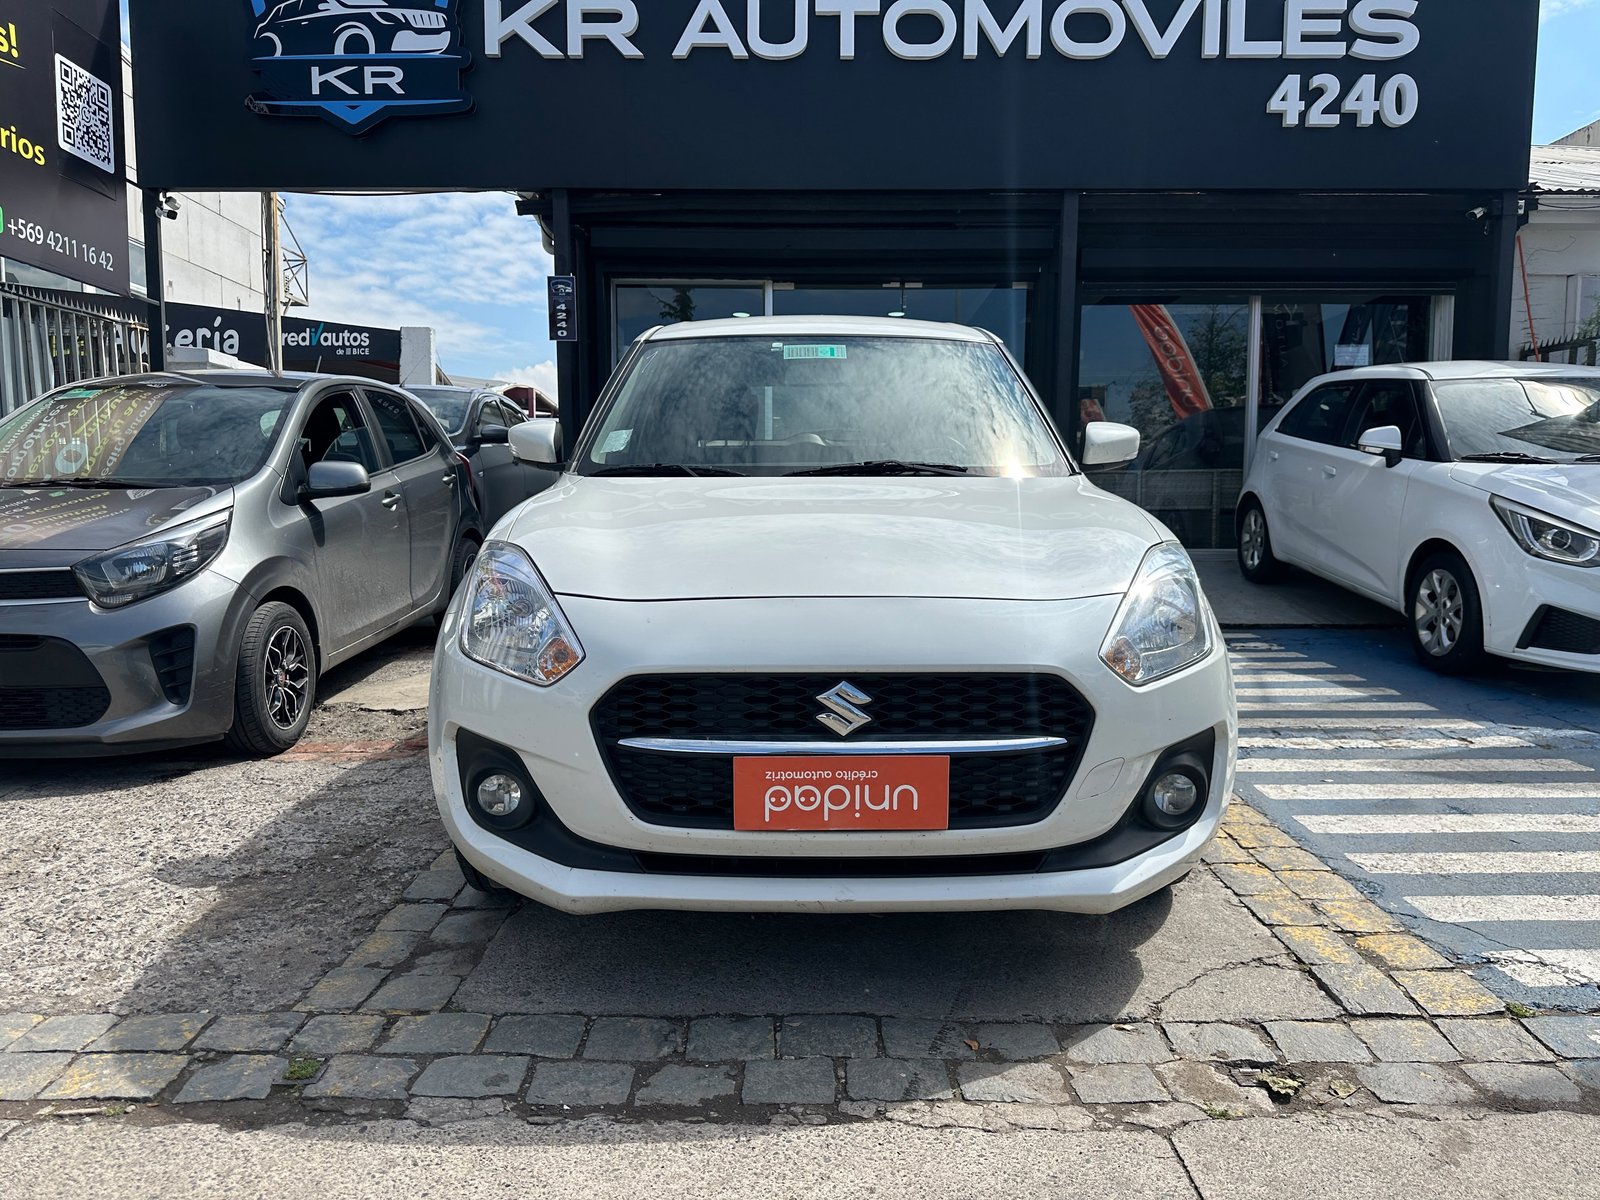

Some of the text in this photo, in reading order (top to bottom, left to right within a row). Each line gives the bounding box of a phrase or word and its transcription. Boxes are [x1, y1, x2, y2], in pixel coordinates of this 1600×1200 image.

[484, 0, 1420, 61] KR AUTOMOVILES
[310, 66, 406, 96] KR
[1266, 73, 1420, 129] 4240
[7, 217, 114, 272] +569 4211 16 42
[555, 303, 568, 337] 4240
[336, 347, 370, 355] de BICE
[764, 770, 879, 782] crédito automotriz
[764, 783, 919, 822] unidad
